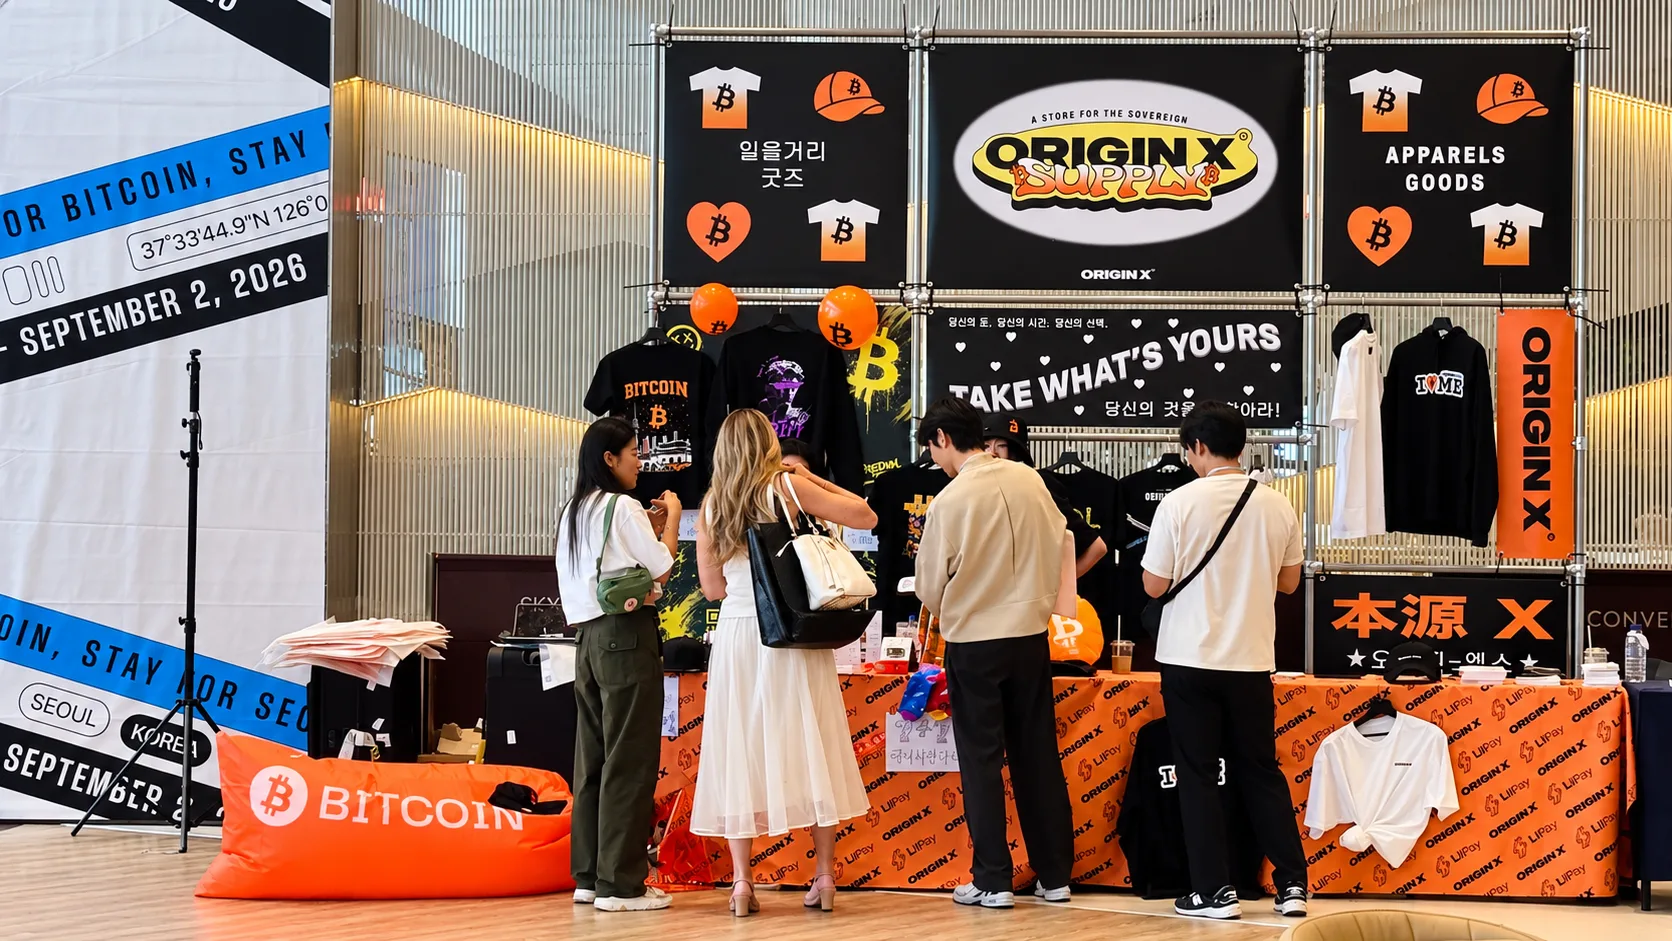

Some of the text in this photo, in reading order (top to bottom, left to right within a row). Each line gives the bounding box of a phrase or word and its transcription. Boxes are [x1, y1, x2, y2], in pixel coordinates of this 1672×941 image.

[1031, 109, 1188, 124] A STORE FOR THE SOVEREIGN
[739, 140, 826, 162] 일을거리
[1385, 146, 1505, 164] APPARELS
[3, 129, 308, 239] OR BITCOIN, STAY
[761, 168, 804, 189] 굿즈
[1016, 157, 1209, 198] SUPPLY
[1405, 173, 1485, 192] GOODS
[19, 287, 182, 356] SEPTEMBER
[190, 279, 221, 309] 2,
[229, 252, 308, 299] 2026
[1038, 341, 1164, 403] WHAT'S
[1167, 322, 1283, 363] YOURS
[624, 379, 689, 400] BITCOIN
[1105, 400, 1154, 418] 당신의
[1227, 400, 1280, 418] 아라!
[1331, 592, 1554, 640] 本源 X
[1587, 610, 1671, 628] CONVE
[0, 614, 60, 661] OIN,
[82, 640, 164, 686] STAY
[254, 692, 308, 734] SEO
[30, 693, 97, 728] SEOUL
[319, 785, 524, 831] BITCOIN
